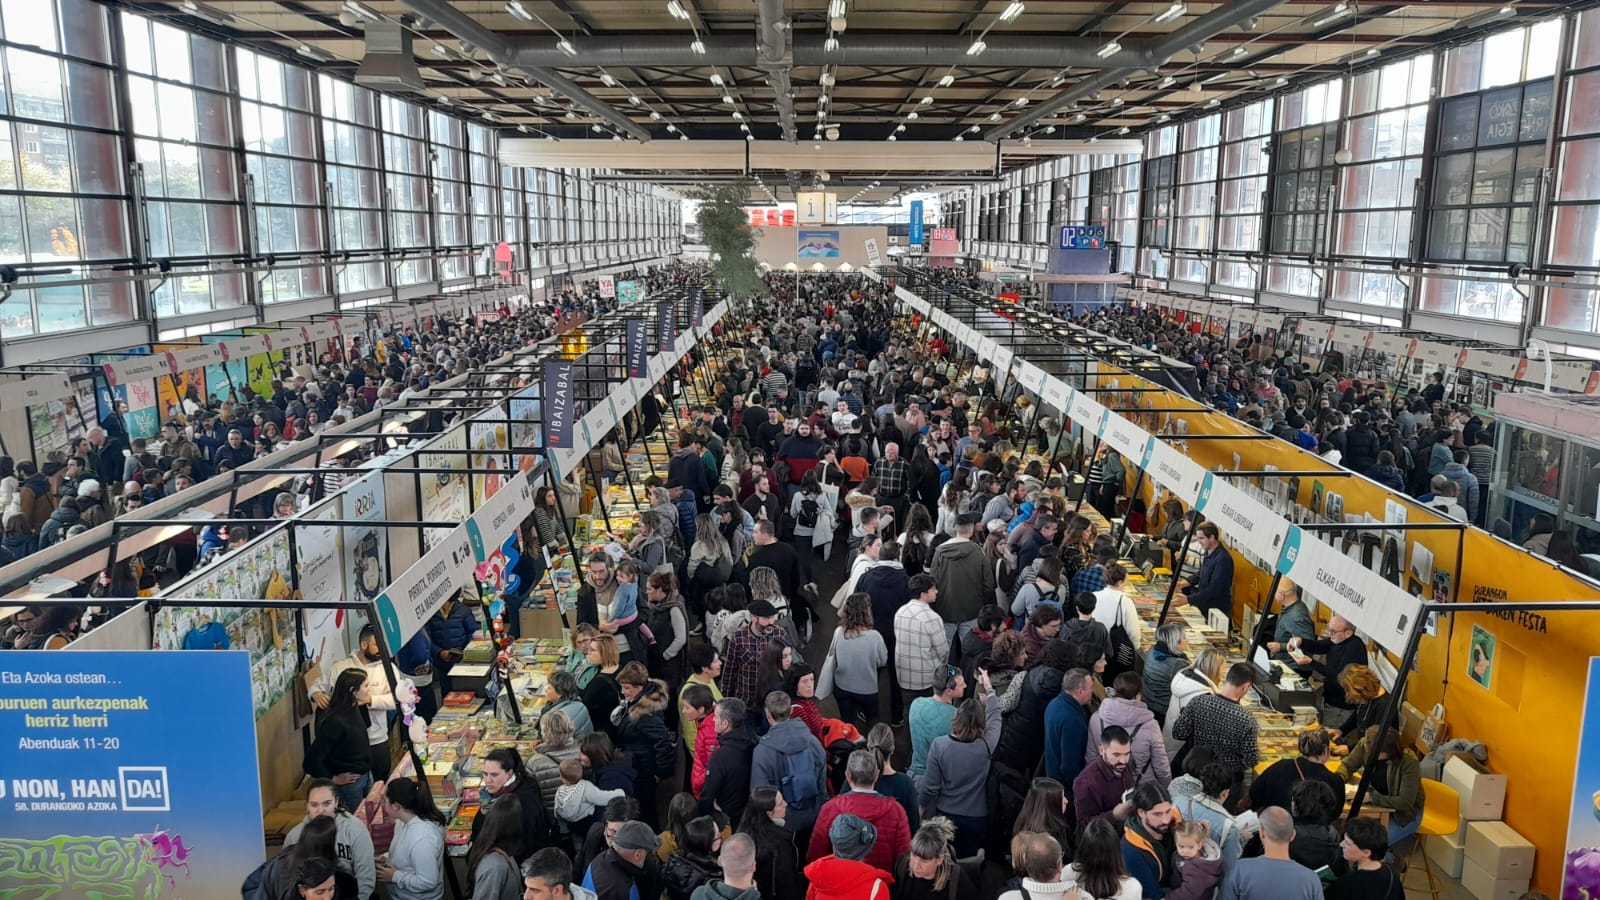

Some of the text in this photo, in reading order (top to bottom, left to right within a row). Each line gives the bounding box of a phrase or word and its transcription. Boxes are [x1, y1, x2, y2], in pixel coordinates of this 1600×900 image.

[662, 304, 673, 345] IBAIZABAL
[632, 321, 646, 368] IBAIZABAL
[551, 364, 571, 432] IBAIZABAL
[1286, 546, 1298, 562] 65
[407, 559, 447, 602] PIRRITX, PORROTX
[1315, 568, 1366, 609] ELKAR LIBURUAK
[415, 576, 453, 620] ETA MARIMOTOTS
[386, 617, 394, 633] 1
[1518, 610, 1547, 634] FESTA
[2, 671, 22, 684] Eta
[25, 671, 62, 684] Azoka
[52, 696, 149, 713] aurkezpenak
[25, 714, 109, 728] herriz herri
[19, 737, 120, 750] Abenduak 11-20
[13, 779, 66, 800] NON,
[71, 779, 117, 798] HAN
[127, 779, 162, 799] DA!
[32, 802, 85, 811] DURANGOKO
[87, 802, 118, 811] AZOKA
